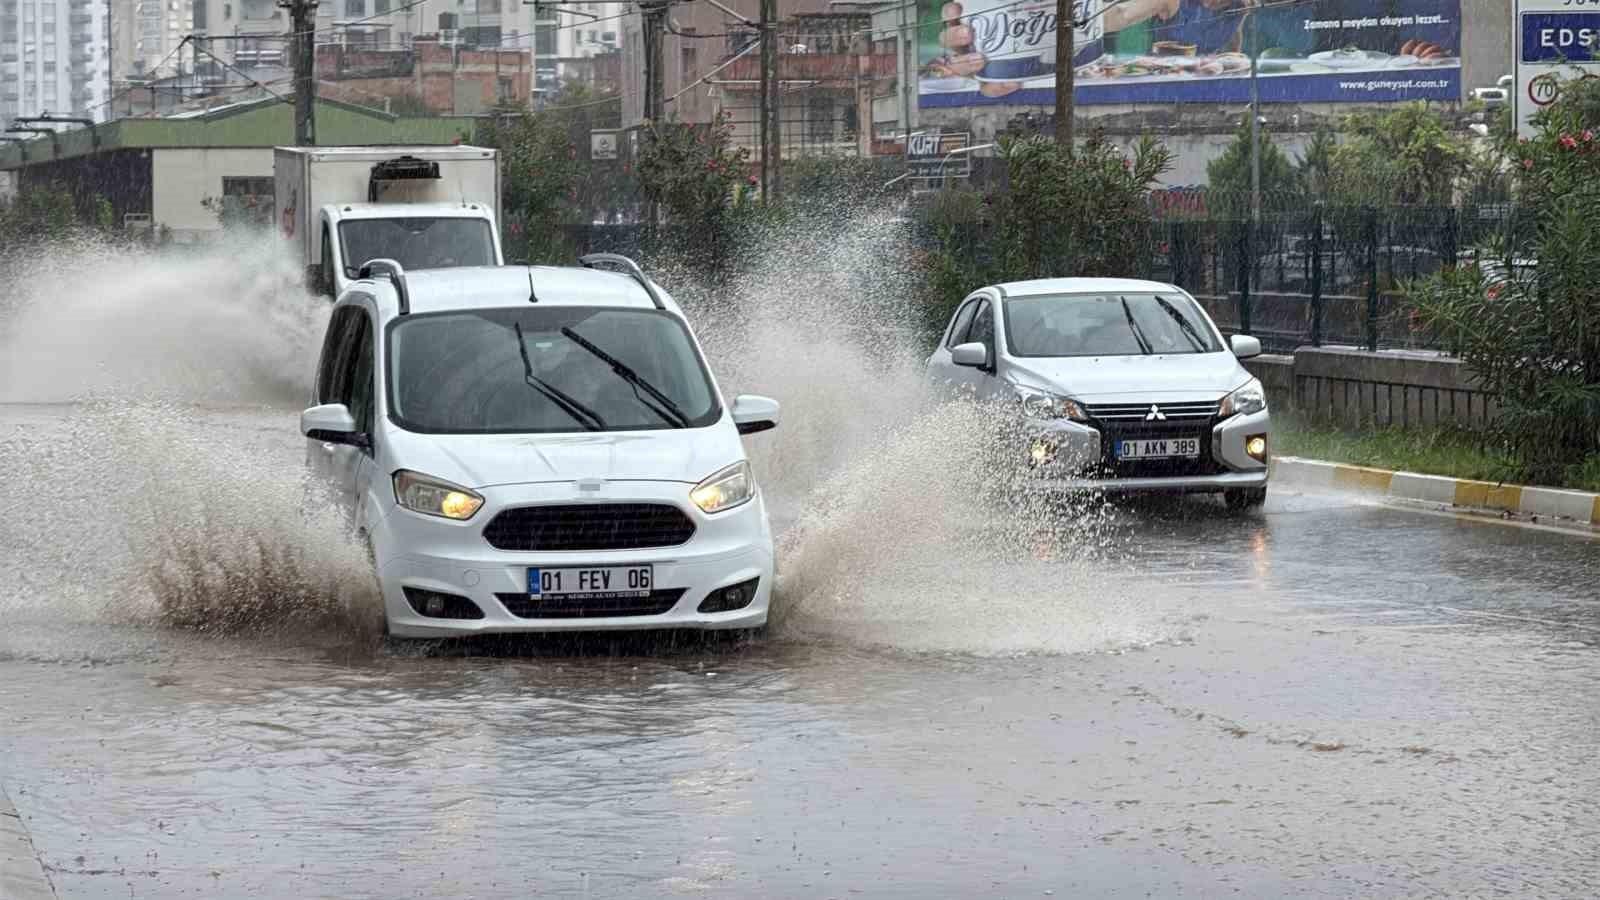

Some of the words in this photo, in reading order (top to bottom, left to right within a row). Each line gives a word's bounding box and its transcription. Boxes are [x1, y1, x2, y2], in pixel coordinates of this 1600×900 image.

[1304, 19, 1341, 31] Zamana
[1342, 17, 1378, 30] meydan
[1380, 15, 1414, 29] okuyan
[1339, 79, 1449, 91] www.guneysut.com.tr
[1536, 82, 1553, 98] 70
[907, 135, 940, 155] KURT
[1123, 442, 1137, 456] 01
[1144, 441, 1167, 455] AKN
[1172, 440, 1196, 454] 389
[542, 571, 561, 591] 01
[579, 570, 611, 590] FEV
[628, 569, 649, 588] 06
